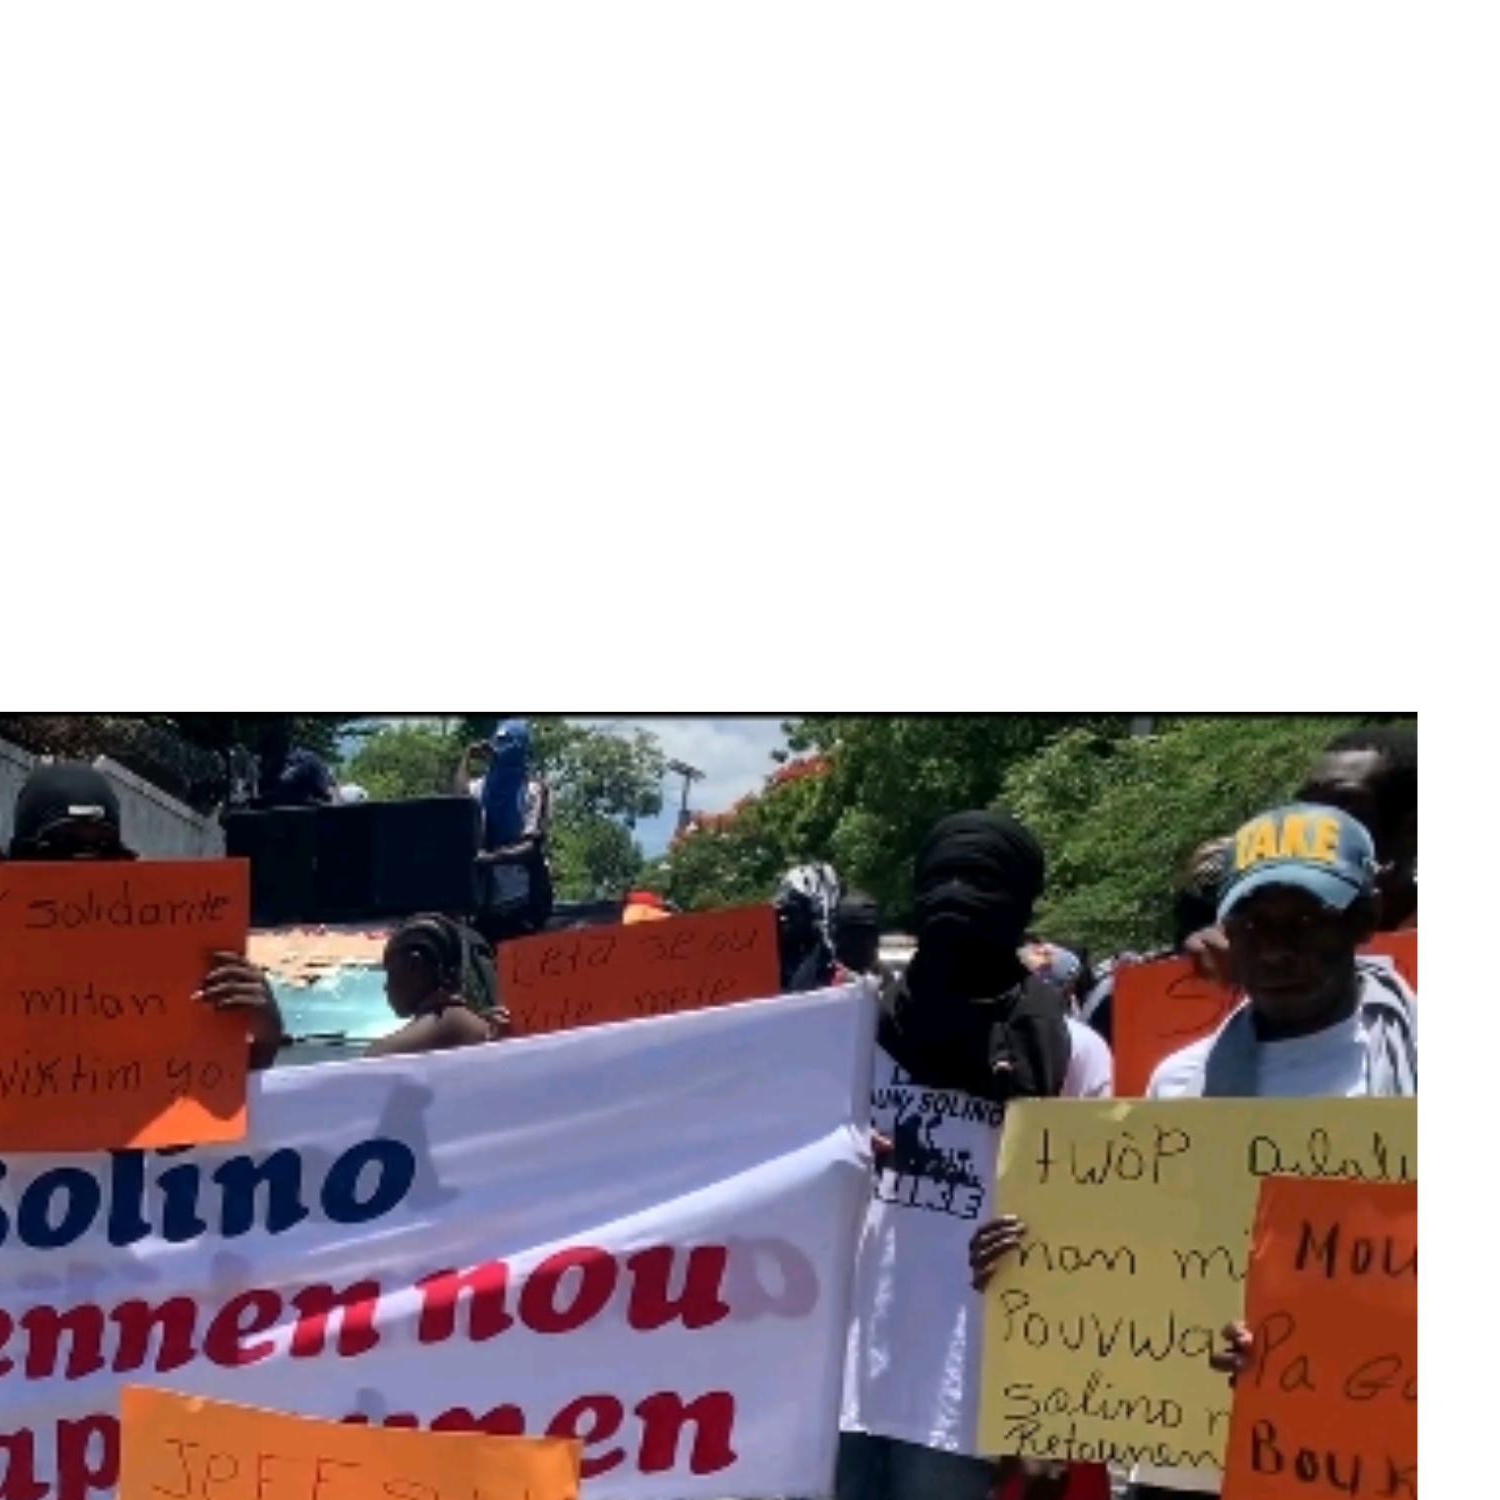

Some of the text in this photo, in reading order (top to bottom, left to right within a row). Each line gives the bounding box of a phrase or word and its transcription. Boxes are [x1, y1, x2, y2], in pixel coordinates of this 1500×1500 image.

[1235, 813, 1339, 870] TAKE
[21, 980, 167, 1019] mitan
[414, 1244, 732, 1344] nou
